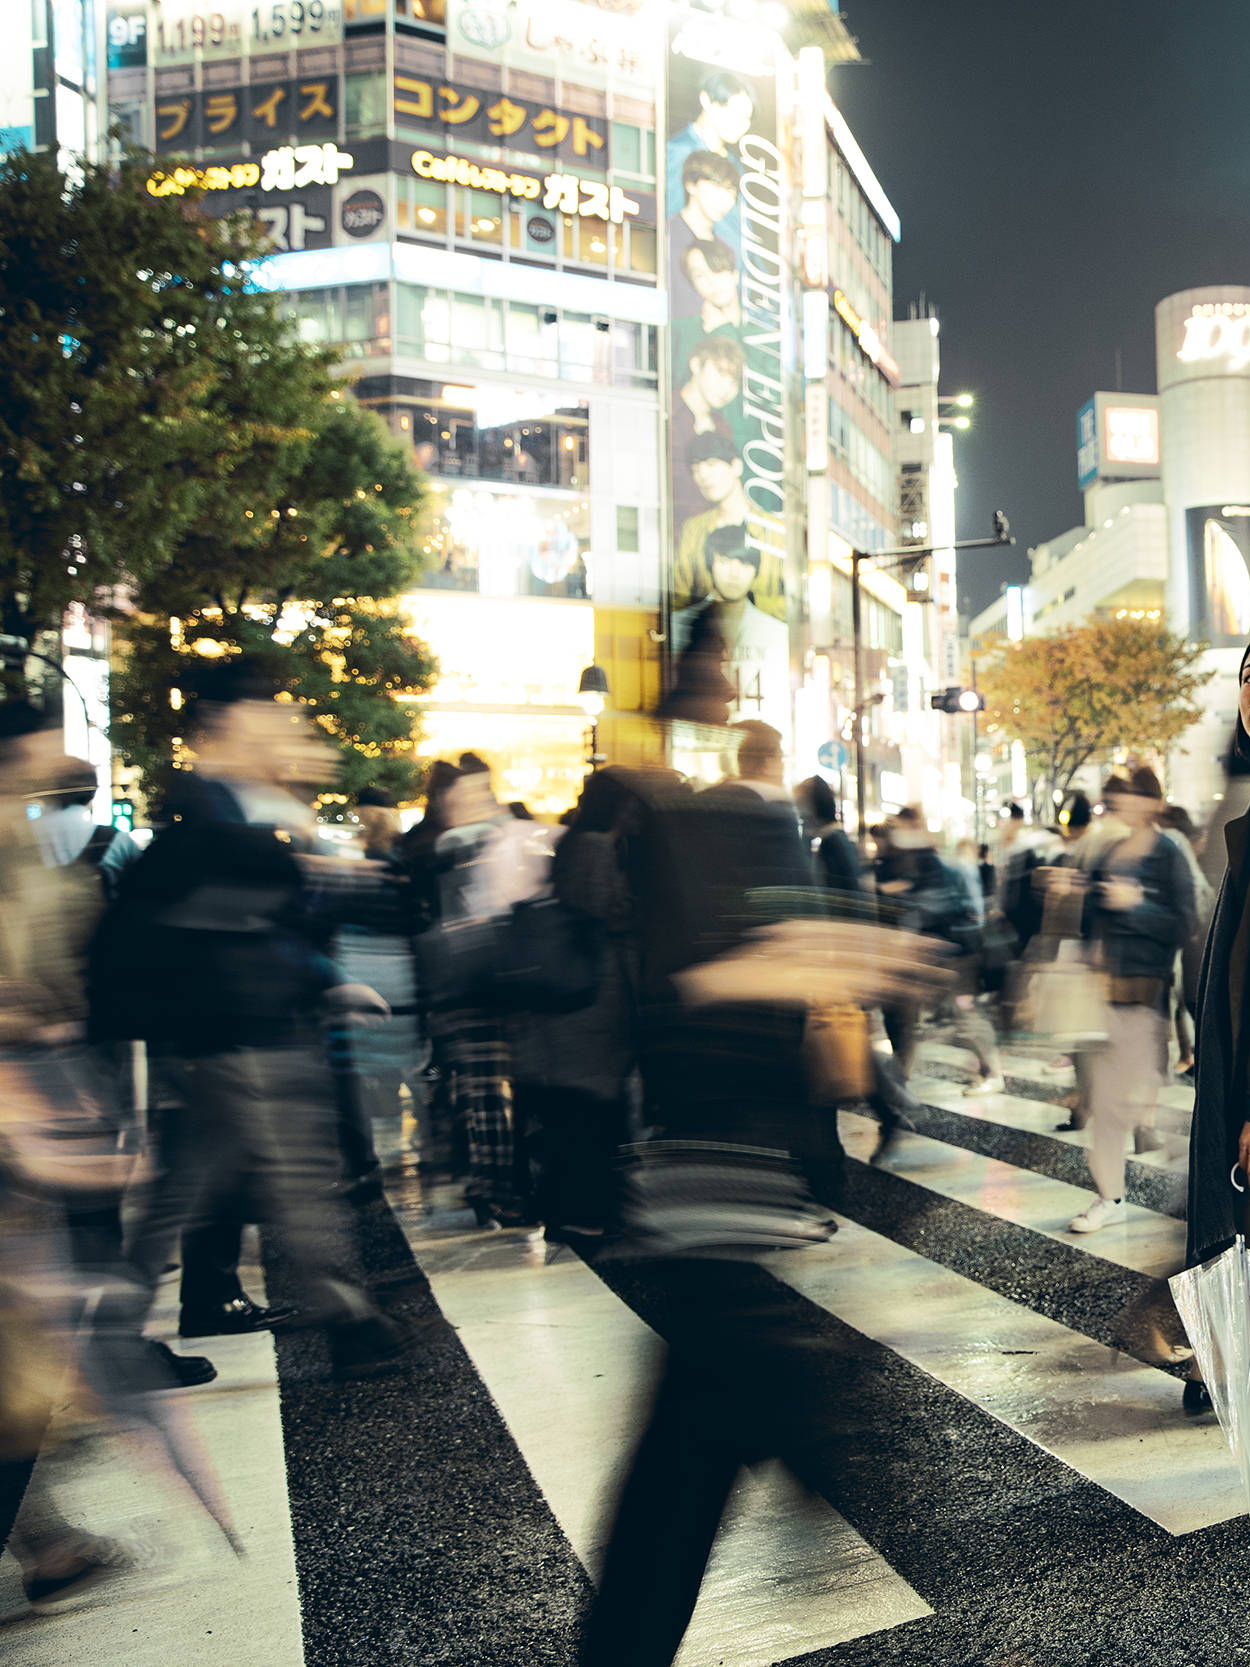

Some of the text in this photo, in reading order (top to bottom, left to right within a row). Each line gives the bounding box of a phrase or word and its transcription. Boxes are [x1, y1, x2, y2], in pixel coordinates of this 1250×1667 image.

[109, 16, 146, 46] 9F
[157, 82, 335, 140] プライス
[394, 75, 605, 156] コンタクト
[261, 142, 354, 192] ガスト
[543, 173, 641, 224] ガスト
[739, 133, 789, 560] GOLDEN EPOCH
